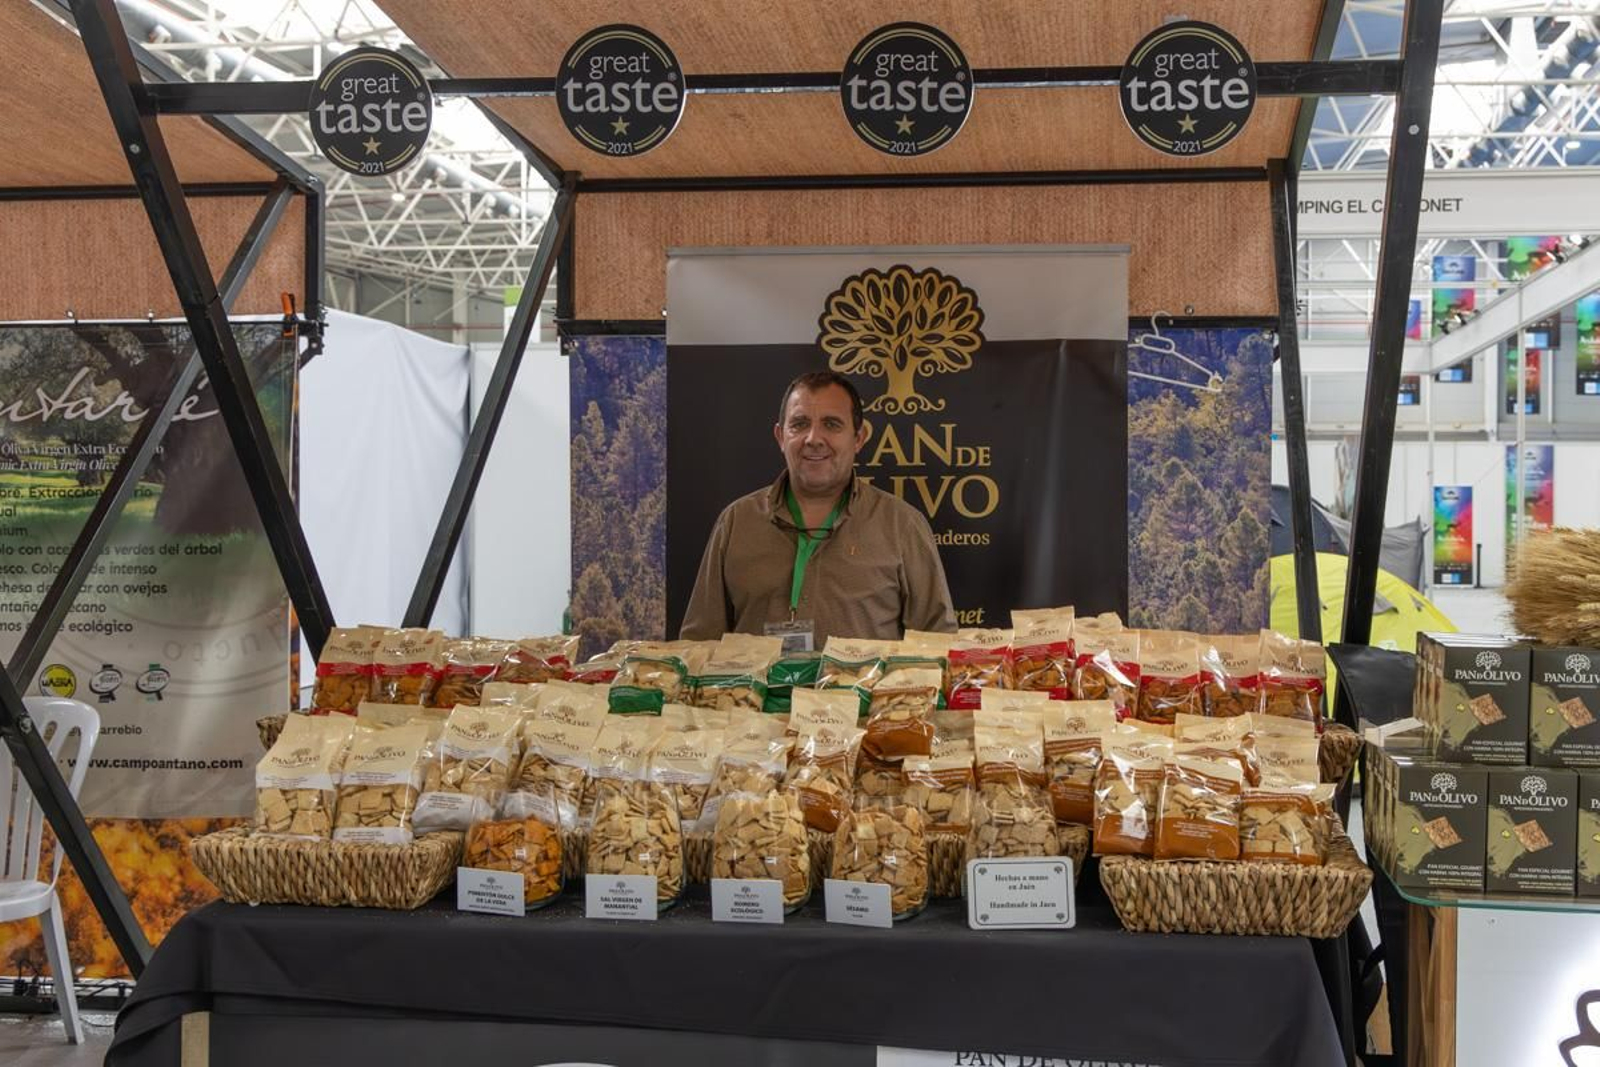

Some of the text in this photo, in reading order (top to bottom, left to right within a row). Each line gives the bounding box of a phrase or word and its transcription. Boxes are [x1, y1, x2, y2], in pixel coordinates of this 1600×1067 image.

[590, 52, 651, 80] great
[876, 50, 939, 78] great
[1155, 48, 1220, 76] great
[341, 73, 400, 100] great
[847, 74, 966, 113] taste
[1126, 74, 1250, 112] taste
[562, 77, 679, 113] taste
[315, 98, 427, 134] taste
[607, 142, 633, 154] 2021
[889, 141, 917, 154] 2021
[1173, 140, 1201, 153] 2021
[360, 162, 385, 174] 2021
[1296, 200, 1343, 214] MPING
[1347, 200, 1367, 213] EL
[2, 443, 29, 456] Oliva
[31, 444, 71, 458] Virgen
[74, 443, 106, 455] Extra
[20, 459, 49, 471] Extra
[53, 459, 87, 472] Virgin
[88, 459, 118, 471] Olive
[18, 546, 43, 556] con
[114, 544, 156, 556] verdes
[159, 544, 180, 556] del
[109, 563, 157, 575] intenso
[96, 585, 119, 594] con
[123, 582, 168, 597] ovejas
[69, 619, 133, 635] ecológico
[989, 901, 1029, 909] Handmade
